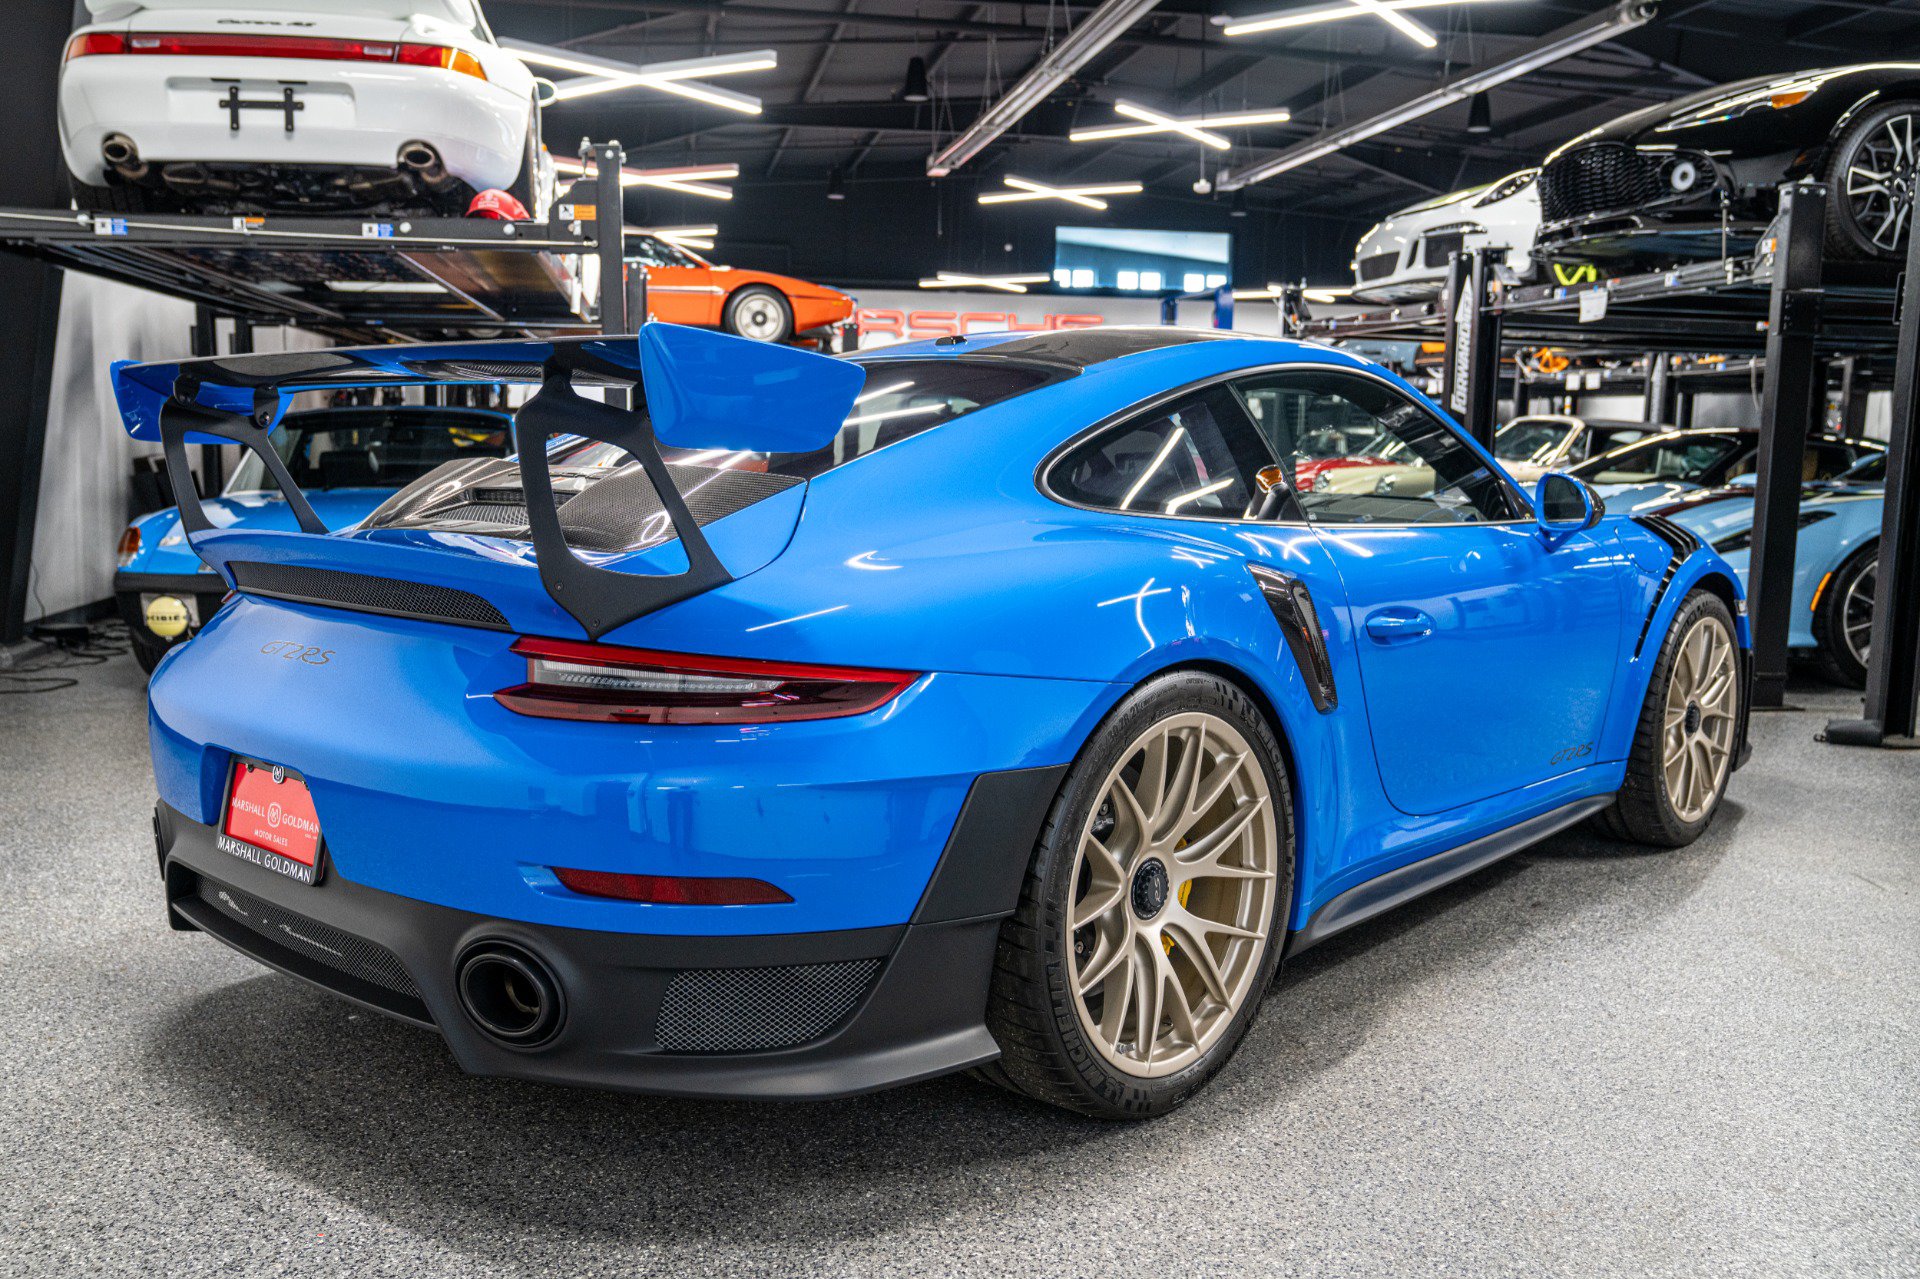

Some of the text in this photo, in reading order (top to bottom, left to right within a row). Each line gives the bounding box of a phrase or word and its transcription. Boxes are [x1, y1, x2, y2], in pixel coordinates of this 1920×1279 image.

[232, 797, 319, 832] MARSHALL GOLDMAN
[272, 834, 288, 847] SALES
[217, 836, 312, 883] MARSHALL GOLDMAN
